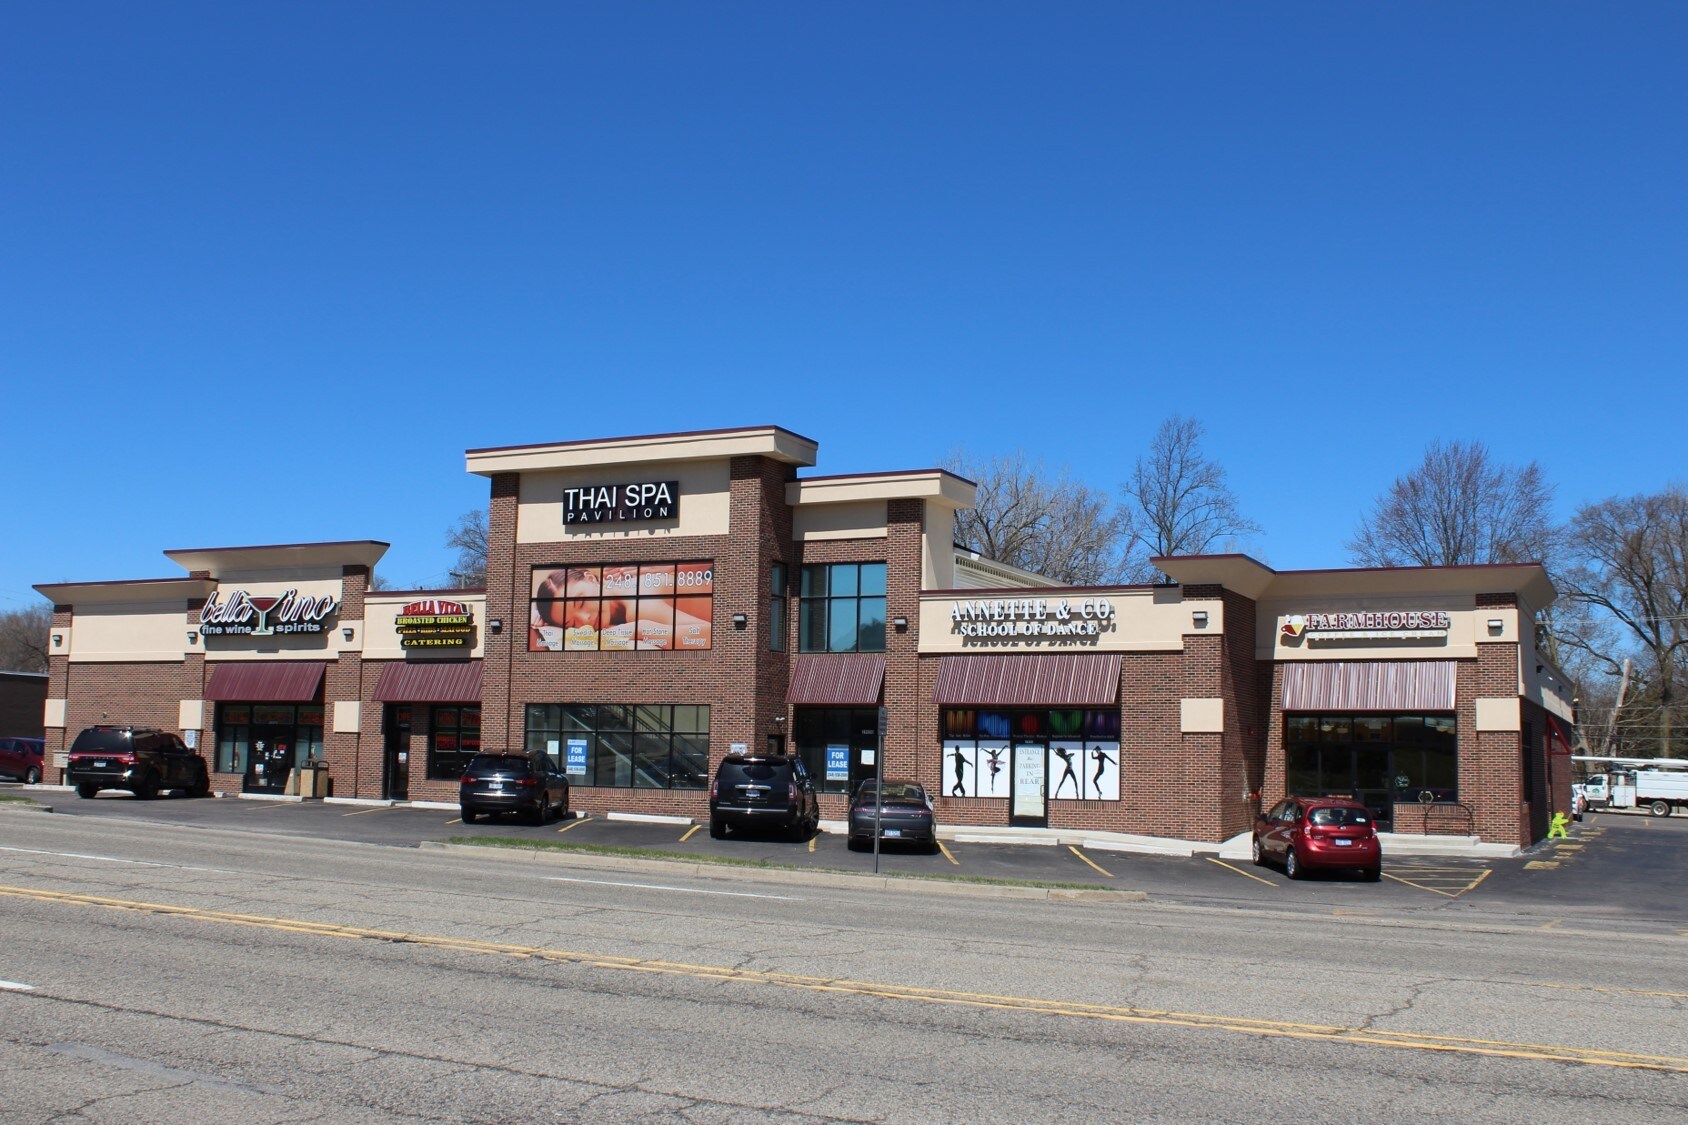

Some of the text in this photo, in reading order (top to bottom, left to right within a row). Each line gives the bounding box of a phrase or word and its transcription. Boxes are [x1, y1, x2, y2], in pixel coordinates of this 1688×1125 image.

[564, 483, 672, 510] THAI SPA
[567, 507, 668, 522] PAVILION
[678, 570, 712, 586] 8889
[200, 591, 254, 623] bella
[403, 600, 463, 615] BELLA VITA
[951, 598, 1115, 621] ANNETTE & CO.
[437, 616, 467, 624] CHICKEN
[1306, 612, 1448, 630] FARMHOUSE
[202, 622, 321, 634] fine wine spirits
[960, 623, 1098, 636] SCHOOL OF DANCE
[404, 638, 463, 646] CATERING
[571, 746, 583, 754] FOR
[567, 755, 586, 763] LEASE
[828, 760, 848, 768] LEASE
